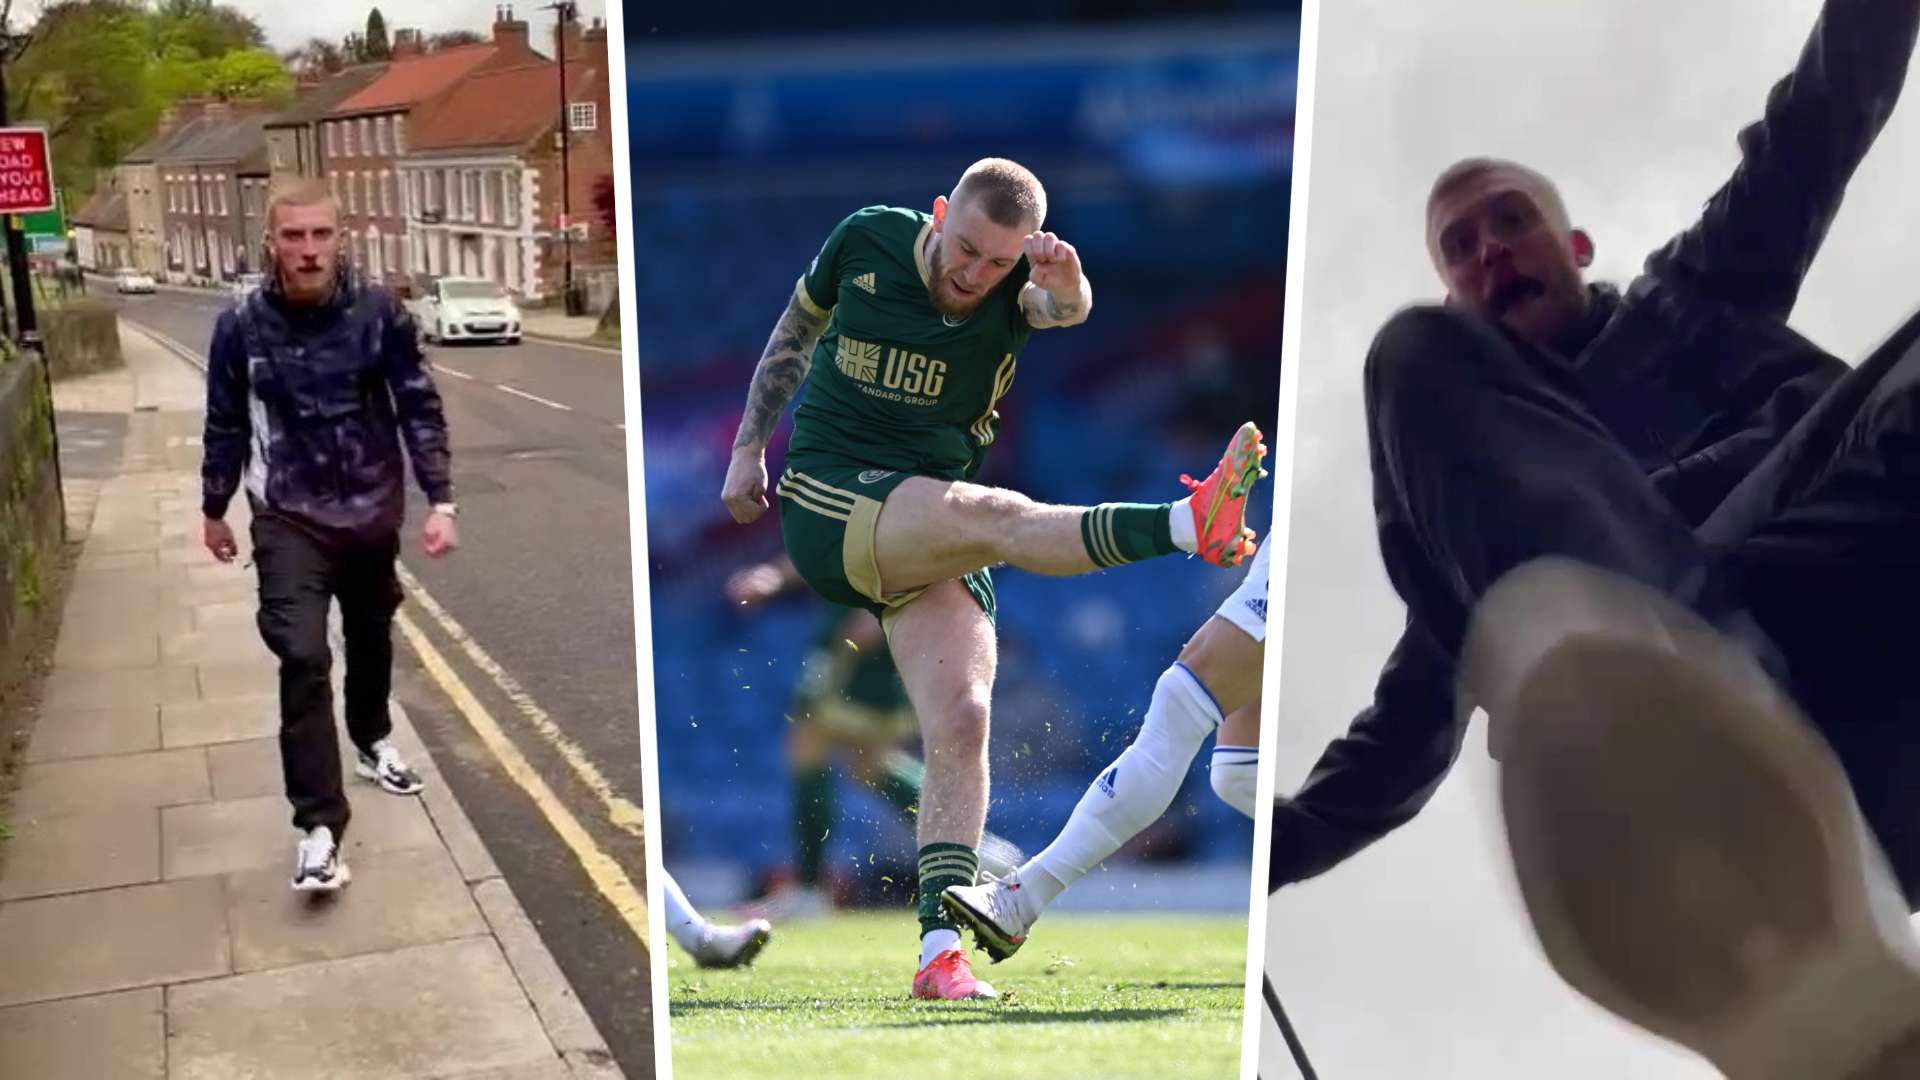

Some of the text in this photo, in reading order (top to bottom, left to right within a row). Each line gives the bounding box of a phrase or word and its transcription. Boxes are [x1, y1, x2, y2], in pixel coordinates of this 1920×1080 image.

[852, 278, 876, 295] adidas
[883, 348, 947, 396] USG
[855, 383, 938, 407] TANDARD GROUP
